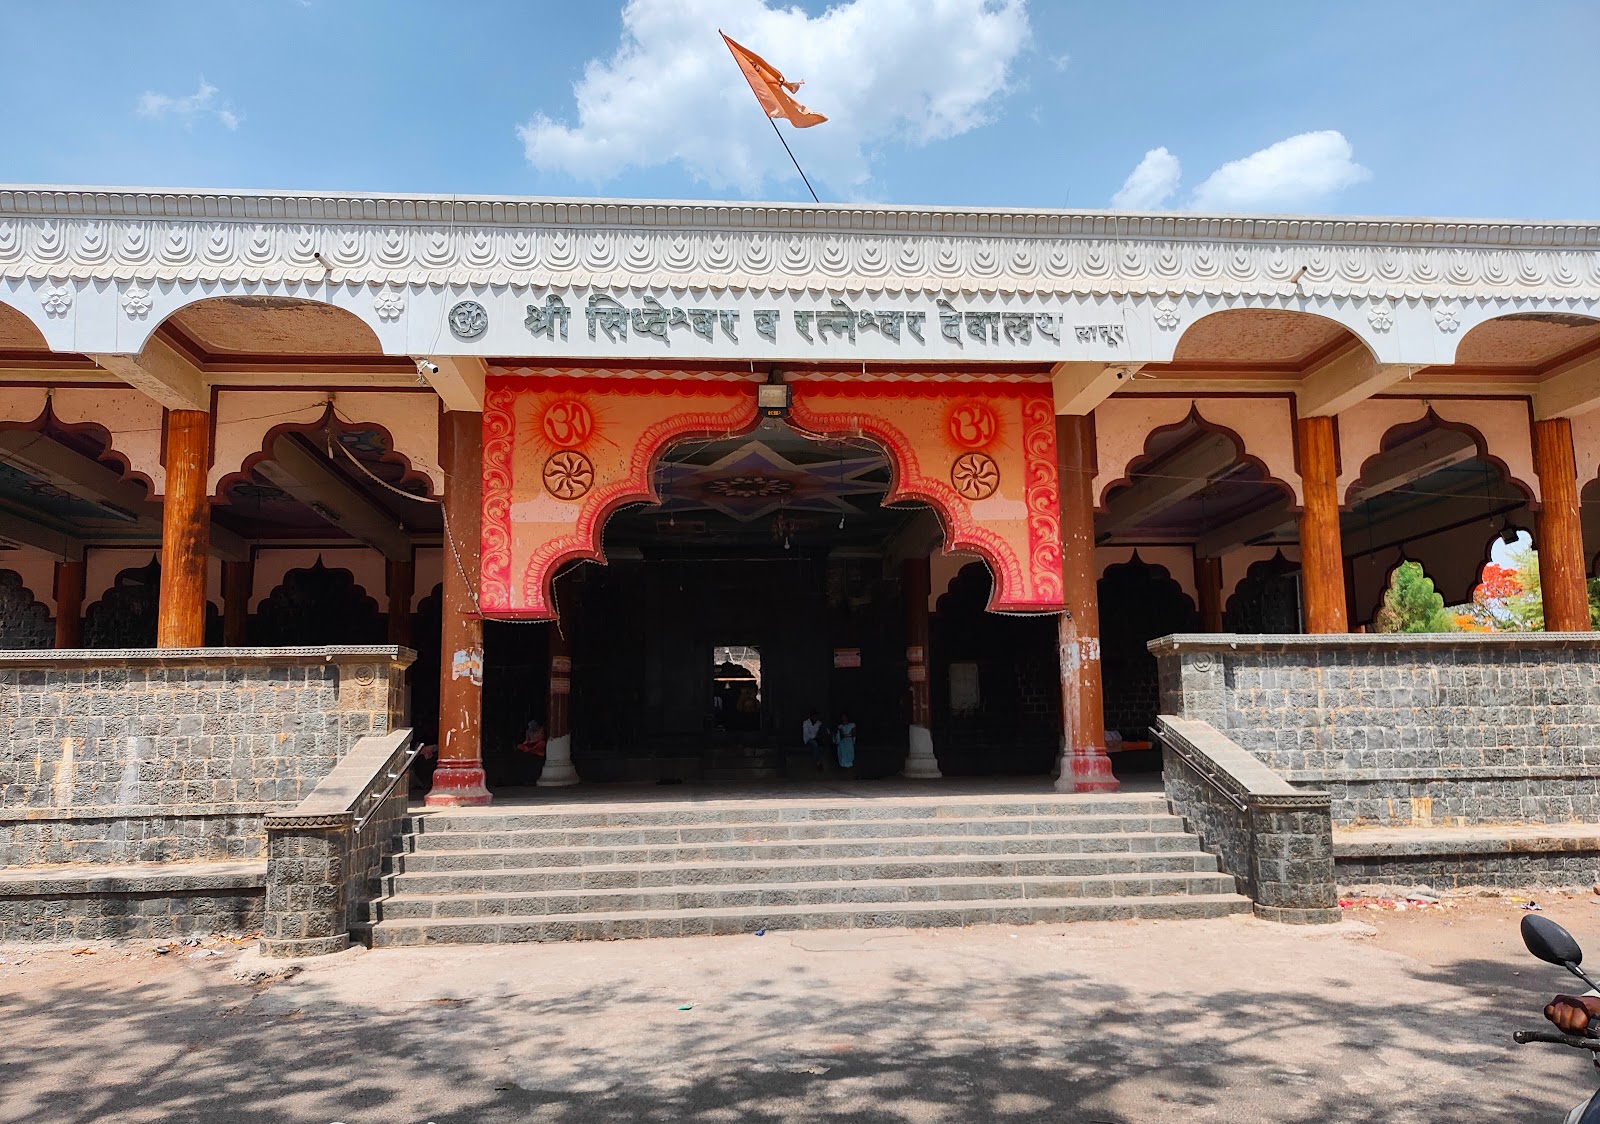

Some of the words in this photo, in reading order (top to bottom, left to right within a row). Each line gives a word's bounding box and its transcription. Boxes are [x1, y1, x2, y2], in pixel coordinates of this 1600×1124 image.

[524, 293, 571, 337] श्री
[754, 310, 779, 339] व
[794, 298, 926, 341] रत्नेश्वर
[936, 299, 1063, 345] देवालय
[1074, 324, 1124, 344] लातूर
